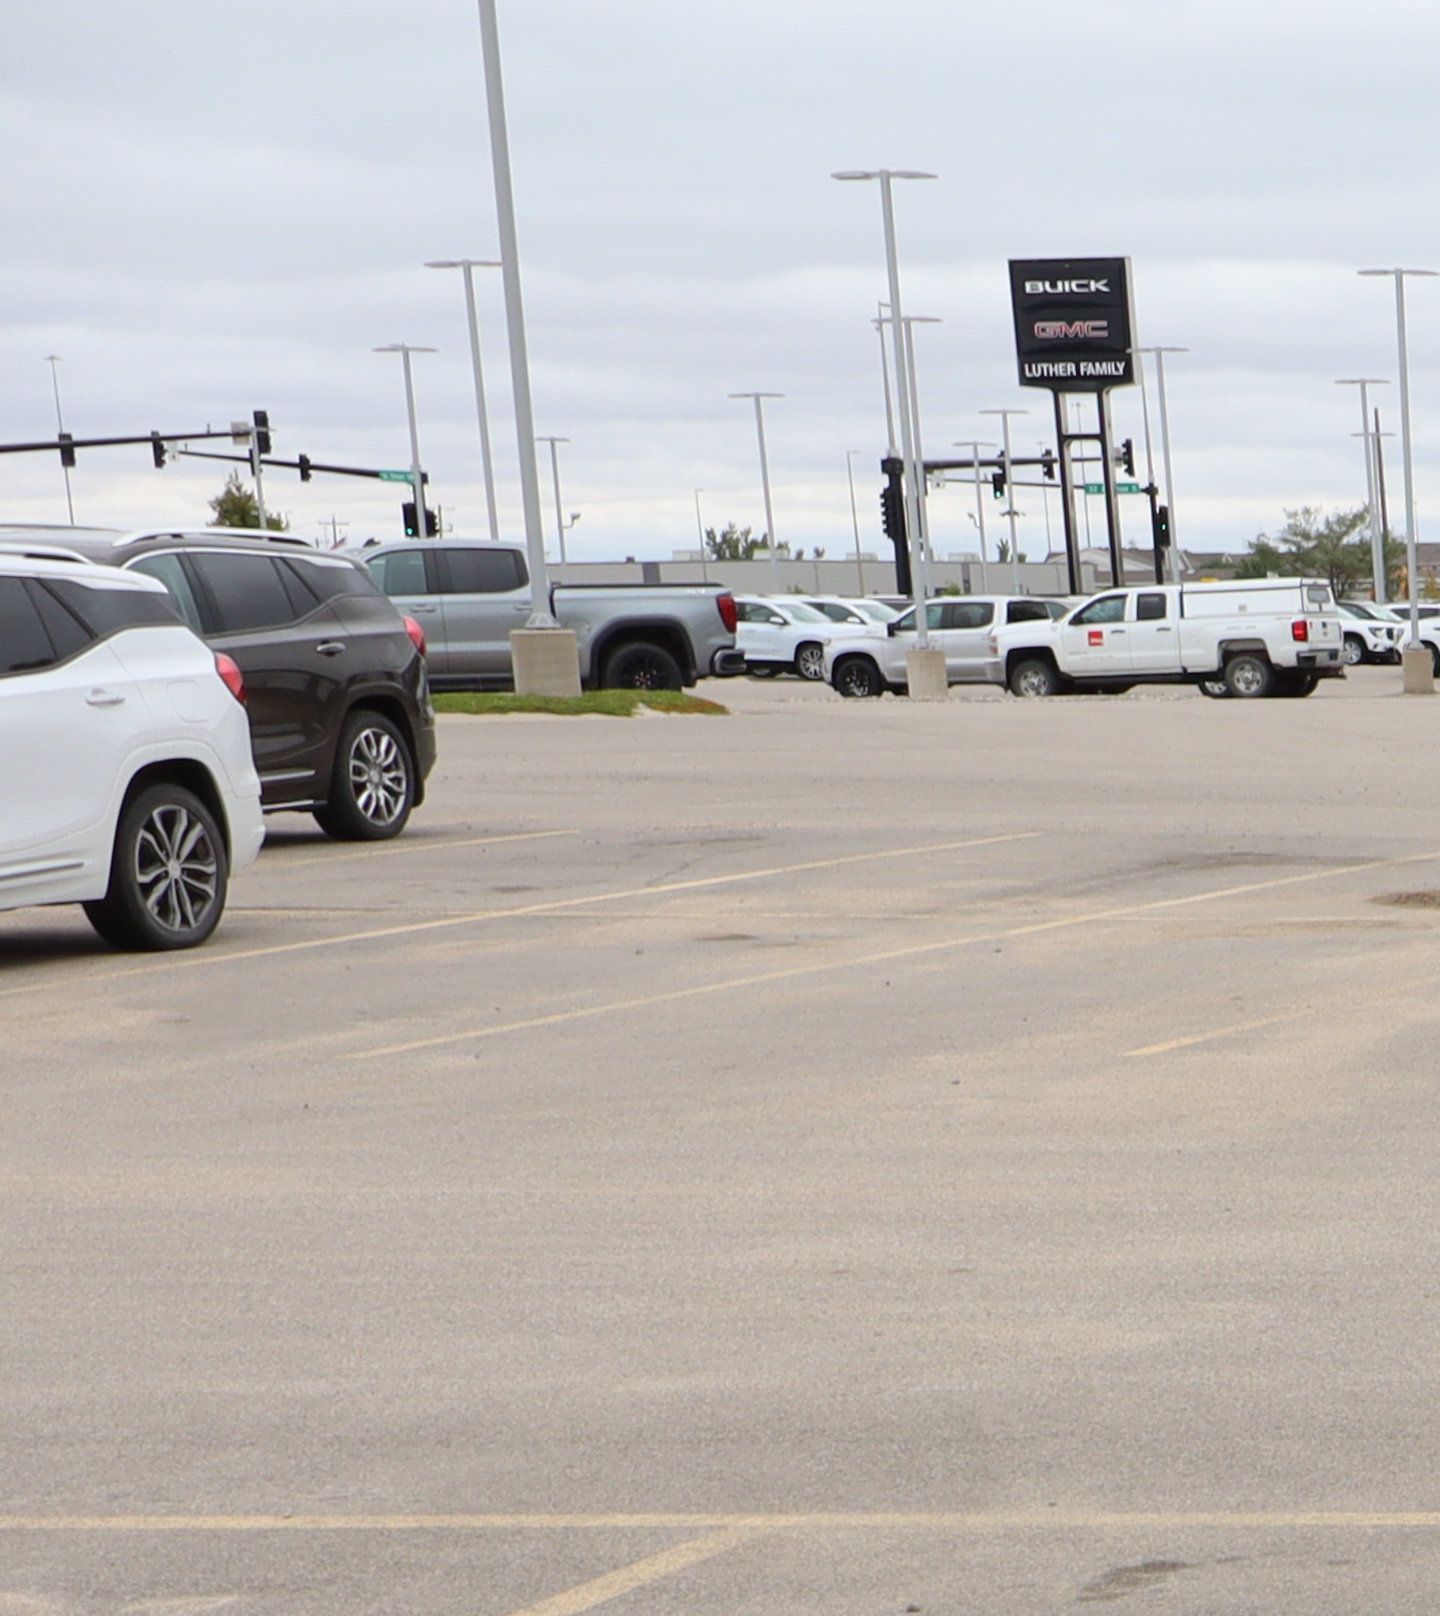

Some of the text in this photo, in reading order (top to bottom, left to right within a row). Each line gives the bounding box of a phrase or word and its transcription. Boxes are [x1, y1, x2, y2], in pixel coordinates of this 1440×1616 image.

[1024, 279, 1111, 294] BUICK
[1034, 320, 1109, 339] GMC
[1024, 361, 1126, 378] LUTHER FAMILY
